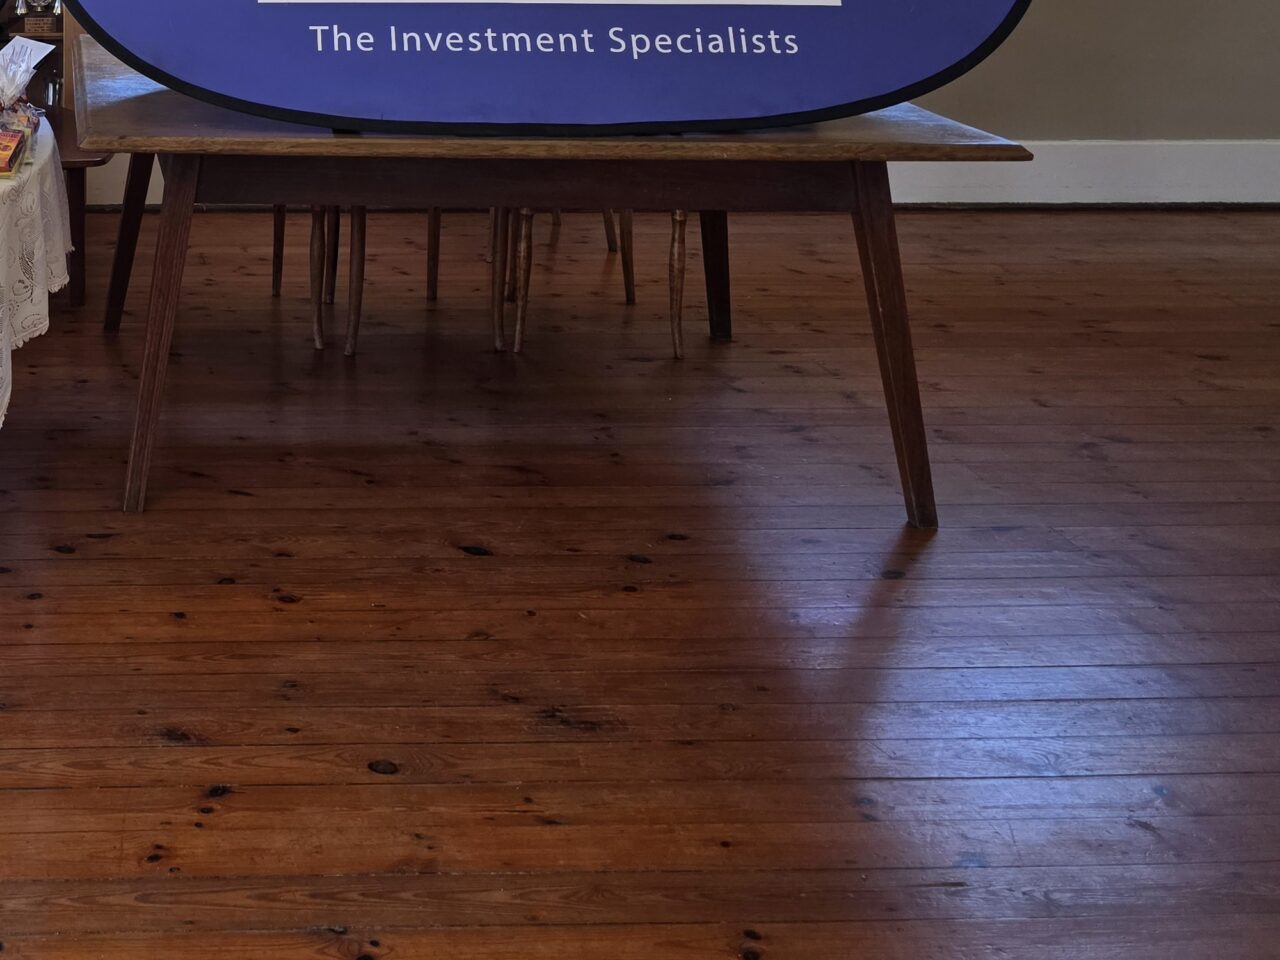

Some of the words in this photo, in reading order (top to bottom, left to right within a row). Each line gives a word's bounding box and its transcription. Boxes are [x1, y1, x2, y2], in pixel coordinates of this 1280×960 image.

[308, 24, 375, 52] The
[390, 25, 595, 53] Investment
[608, 26, 799, 60] Specialists
